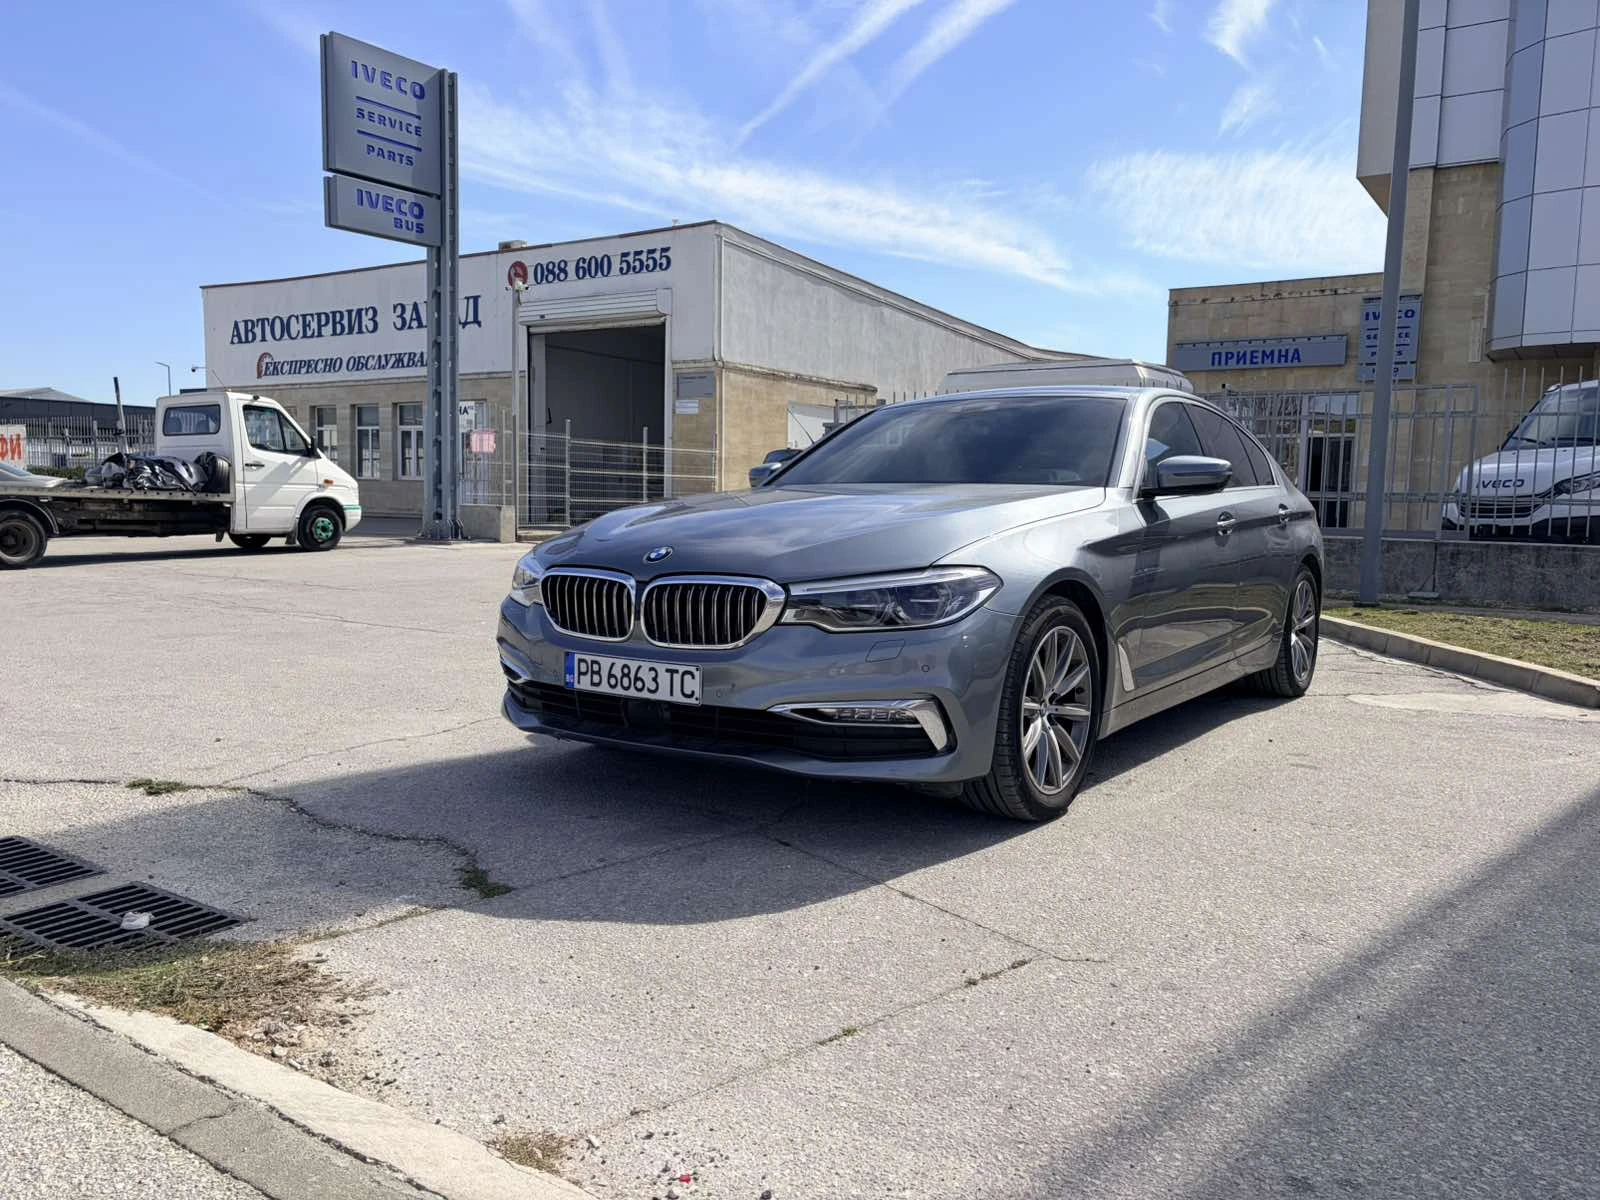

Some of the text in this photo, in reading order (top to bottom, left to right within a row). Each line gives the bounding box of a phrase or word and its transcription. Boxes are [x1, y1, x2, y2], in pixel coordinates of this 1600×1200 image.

[351, 60, 425, 100] IVECO
[356, 107, 423, 137] SERVICE
[366, 143, 414, 167] PARTS
[356, 188, 425, 220] IVECO
[393, 217, 425, 234] BUS
[533, 247, 672, 285] 088 600 5555
[230, 295, 482, 345] АВТОСЕРВИЗ ЗАД
[1365, 309, 1415, 321] IVO
[263, 351, 428, 377] ЕКСПРЕСНО ОБСЛУЖВА
[1211, 347, 1302, 367] ПРИЕМНА
[577, 658, 696, 699] PB 6863 TC
